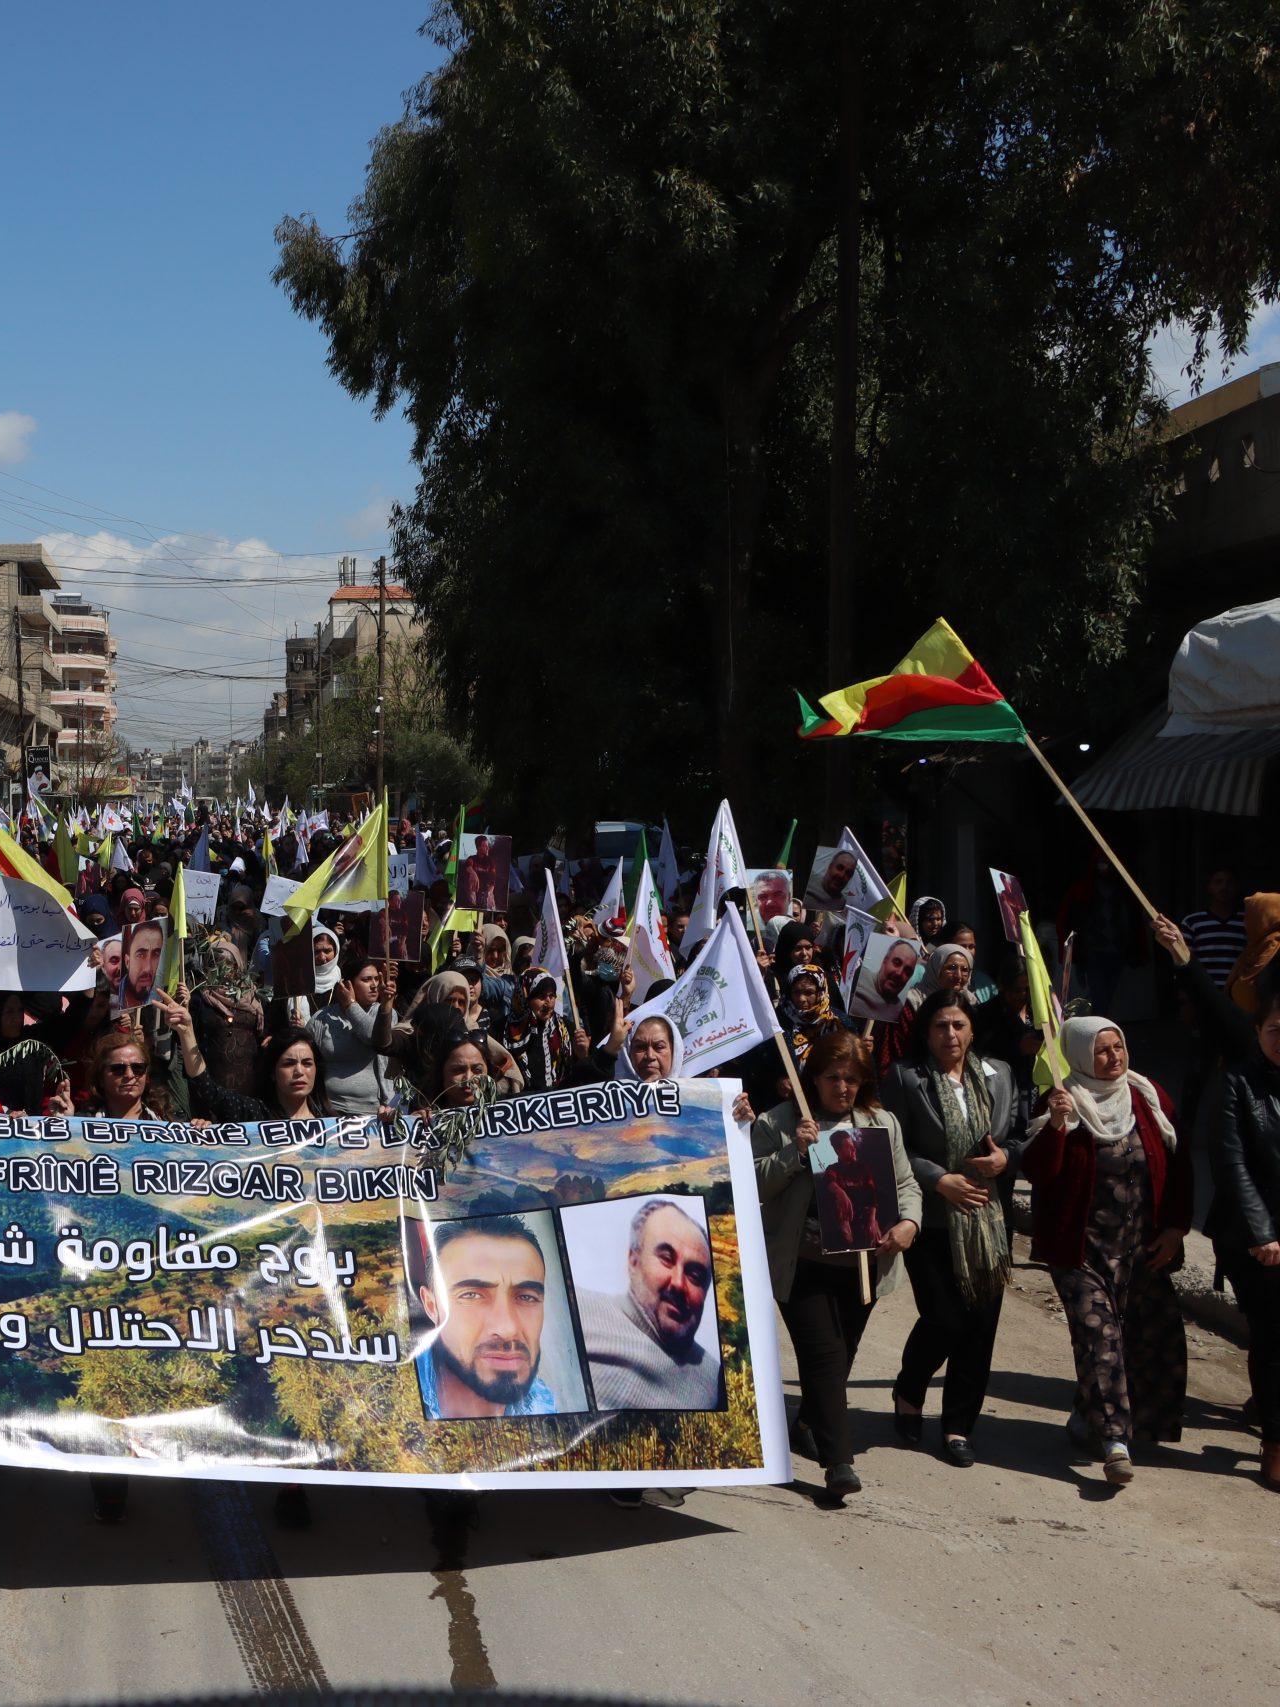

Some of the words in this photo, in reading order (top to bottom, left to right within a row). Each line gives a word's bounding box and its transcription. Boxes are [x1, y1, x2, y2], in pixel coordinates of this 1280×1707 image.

[82, 1119, 249, 1146] EFRÎNÊ
[261, 1117, 326, 1148] EM
[380, 1080, 682, 1148] DAIRKERÎYÊ
[132, 1160, 306, 1201] RIZGAR
[316, 1166, 439, 1202] BIKIN
[56, 1225, 238, 1281] مقاومة
[0, 1312, 29, 1350] و
[48, 1306, 237, 1354] الاحتلال
